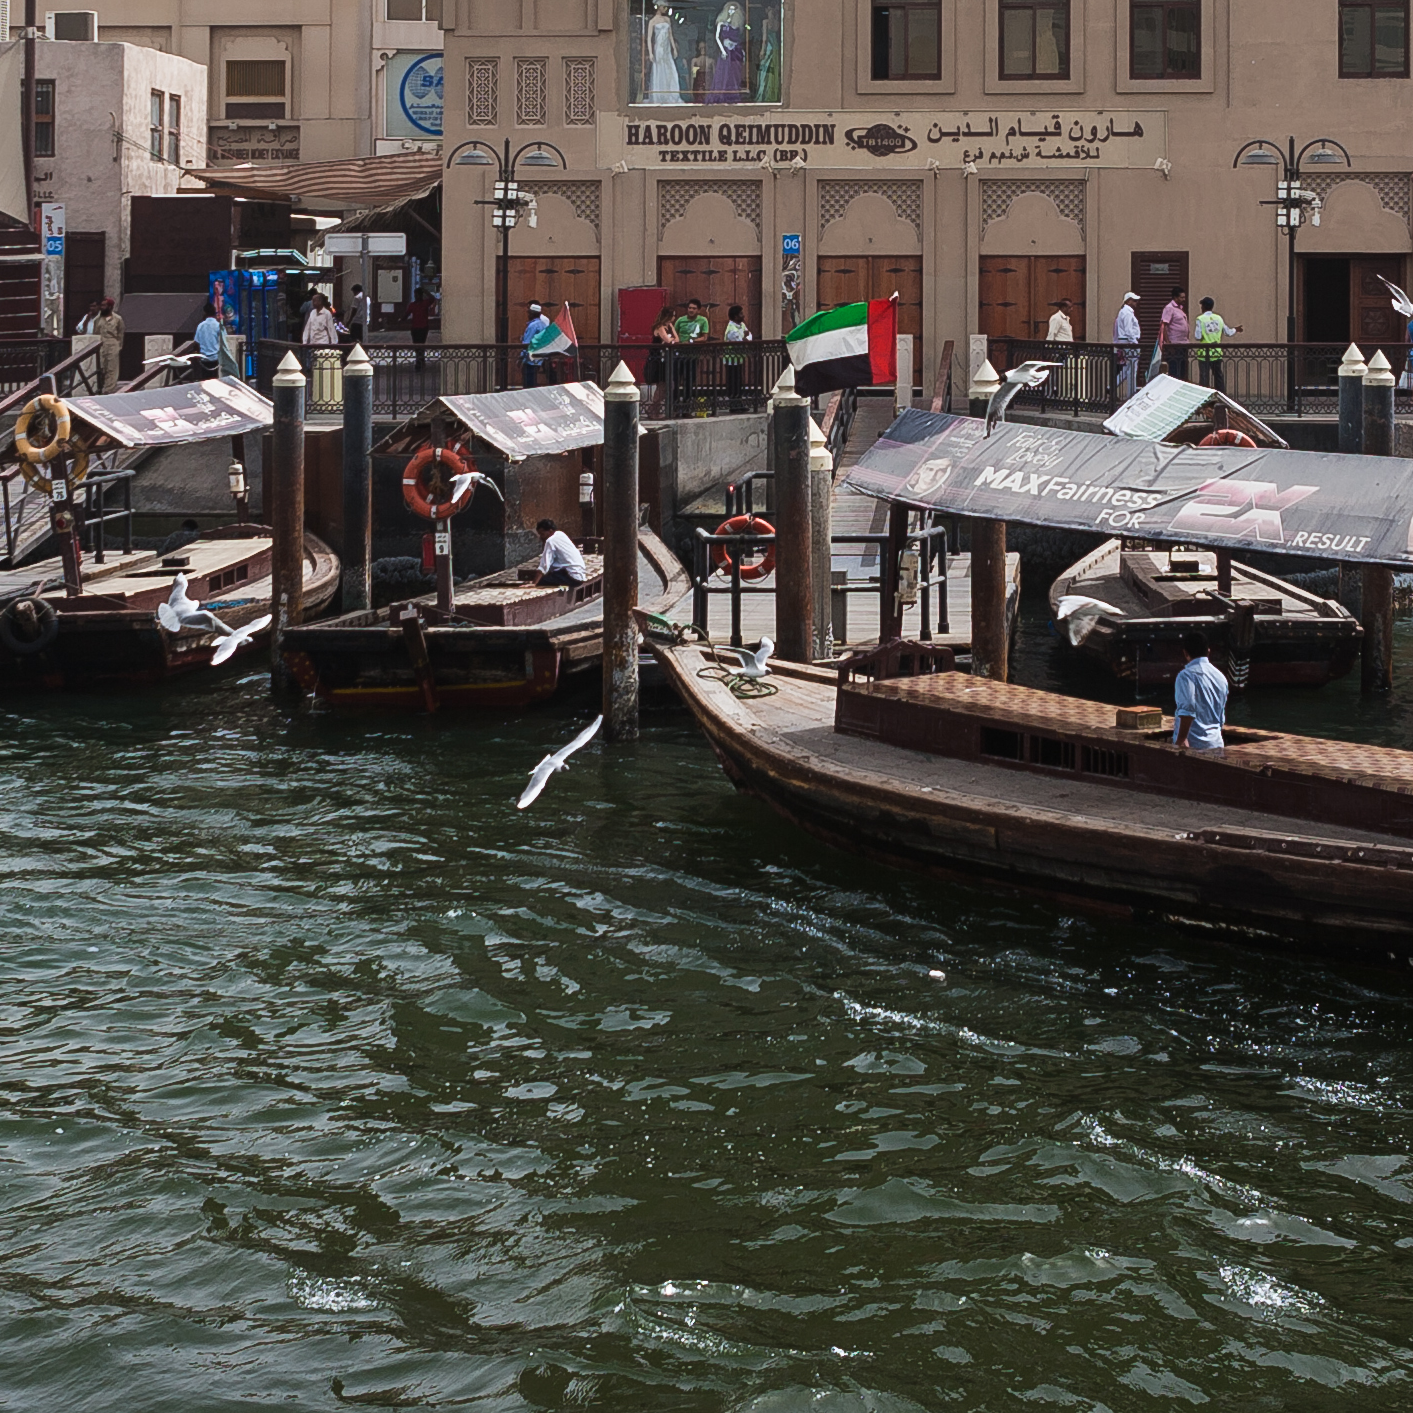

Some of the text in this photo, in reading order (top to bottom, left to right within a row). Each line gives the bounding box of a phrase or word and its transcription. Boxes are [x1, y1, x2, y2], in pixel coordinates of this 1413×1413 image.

[626, 123, 836, 146] HAROON QEIMUDDIN
[927, 114, 1144, 146] هارون قيام الدين
[861, 138, 902, 146] TB1400
[659, 149, 728, 162] TEXTILE
[962, 146, 984, 164] فرع
[1034, 144, 1100, 160] للأقمشة
[48, 241, 62, 251] 05
[784, 239, 799, 249] 06
[1006, 432, 1038, 448] Fair
[1006, 448, 1063, 470] Lovely
[1095, 508, 1145, 529] FOR
[1168, 478, 1320, 543] 2X
